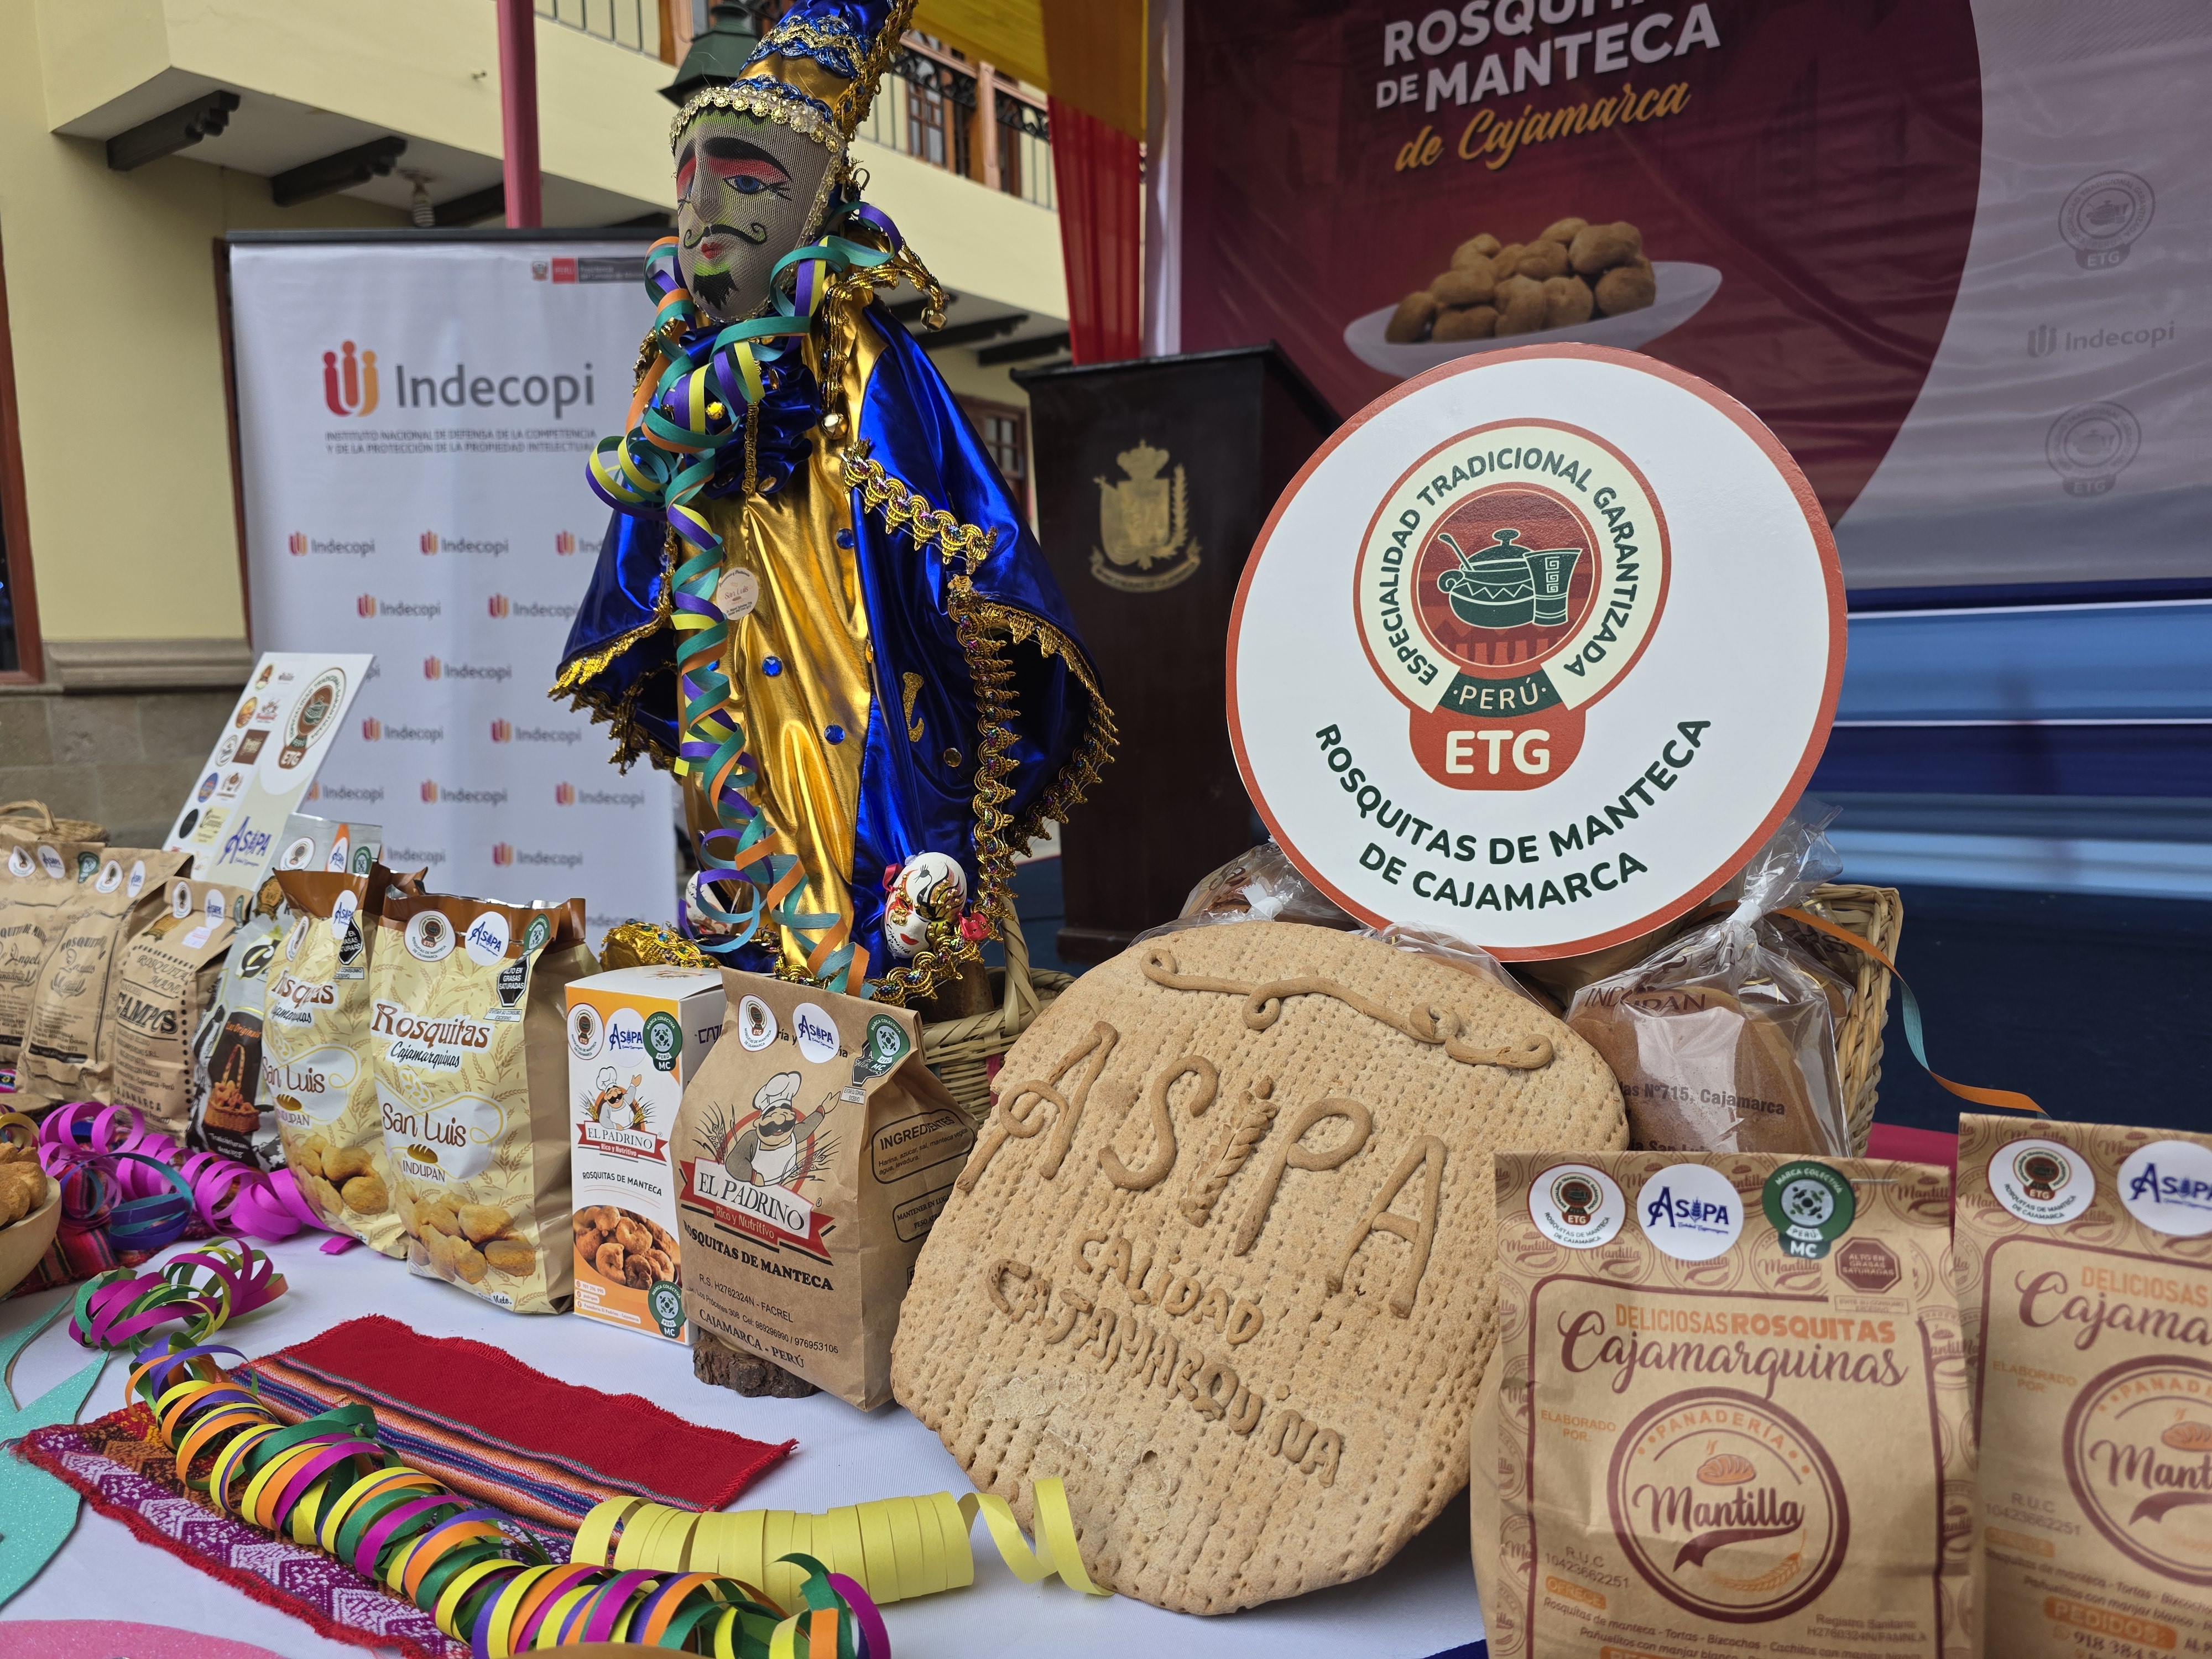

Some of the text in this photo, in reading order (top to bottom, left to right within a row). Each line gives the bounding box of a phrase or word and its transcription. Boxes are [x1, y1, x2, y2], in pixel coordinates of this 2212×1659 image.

[1377, 3, 1720, 112] DE MANTECA
[1395, 82, 1689, 171] de Cajamarca
[2087, 251, 2119, 267] ETG
[2065, 321, 2176, 353] Indecopi
[395, 361, 595, 420] Indecopi
[381, 428, 597, 441] NACIONAL DEFENSA COMPETENCIA
[465, 442, 525, 453] PROPIEDAD
[1416, 447, 1593, 507] TRADICIONAL
[2073, 479, 2106, 494] ETG
[311, 538, 375, 556] Indecopi
[442, 539, 509, 556] Indecopi
[1563, 487, 1640, 677] GARANTIZADA
[1379, 508, 1439, 686] ESPECIALIDAD
[380, 601, 441, 619] Indecopi
[444, 664, 512, 681] Indecopi
[384, 726, 444, 743] Indecopi
[515, 726, 582, 744] Indecopi
[1445, 729, 1550, 775] ETG
[323, 786, 384, 804] Indecopi
[441, 787, 508, 805] Indecopi
[578, 790, 645, 806] Indecopi
[1316, 720, 1711, 865] ROSQUITAS DE MANTECA
[388, 847, 446, 865] Indecopi
[517, 849, 583, 868] Indecopi
[1359, 842, 1648, 911] DE CAJAMARCA
[468, 921, 502, 952] ASIPA
[372, 1004, 491, 1049] Rosquitas
[646, 1016, 676, 1030] MARCA COLECTIVA
[798, 1014, 834, 1045] ASIPA
[870, 1018, 901, 1034] MARCA COLECTIVA
[609, 1023, 643, 1051] ASIPA
[390, 1041, 460, 1069] Cajamarquinas
[262, 1056, 325, 1093] San Luis
[1700, 1088, 1785, 1115] Cajamarca
[383, 1102, 467, 1147] San Luis
[880, 1116, 955, 1150] INGREDIENTES
[588, 1128, 653, 1150] EL PADRINO
[615, 1146, 637, 1157] Nutritivo
[879, 1156, 899, 1167] Harina,
[900, 1148, 919, 1159] azucar,
[930, 1135, 953, 1147] manteca
[954, 1127, 968, 1138] vegetal
[403, 1160, 446, 1183] INDUPAN
[879, 1155, 920, 1175] agua, levadura.
[583, 1171, 662, 1196] ROSQUITAS DE MANTECA
[1775, 1167, 1844, 1195] MARCA COLECTIVA
[698, 1172, 805, 1231] EL PADRINO
[2030, 1190, 2050, 1199] ETG
[2047, 1194, 2077, 1212] MANTECA
[897, 1203, 928, 1221] MANTENER
[928, 1199, 935, 1208] EN
[1568, 1215, 1586, 1224] ETG
[1647, 1186, 1729, 1229] ASIPA
[2022, 1209, 2065, 1220] CAJAMARCA
[716, 1206, 775, 1239] Rico y Nutritivo
[914, 1218, 928, 1229] PESO
[1545, 1212, 1611, 1237] ROSQUITAS MANTECA
[1501, 1238, 1557, 1254] Mantilla
[1563, 1236, 1601, 1244] CAJAMARCA
[1790, 1240, 1818, 1258] MC
[683, 1219, 834, 1291] ROSQUITAS DE MANTECA
[1757, 1259, 1822, 1274] Mantilla
[1843, 1267, 1895, 1276] SATURADAS
[651, 1285, 663, 1296] MARCA
[662, 1284, 681, 1299] COLECTIVA
[700, 1274, 794, 1323] R.S. H2762324N FACREL
[2081, 1265, 2209, 1309] DELICIOSAS
[493, 1296, 512, 1305] Neto.
[664, 1327, 675, 1337] MC
[706, 1295, 839, 1354] Próceres 308 Cel: 989296990 976953105
[1616, 1303, 1896, 1344] DELICIOSAS ROSQUITAS
[700, 1308, 805, 1369] CAJAMARCA PERÚ
[1557, 1310, 1909, 1400] Cajamarquinas
[1993, 1360, 2078, 1386] ELABORADO
[1541, 1409, 1617, 1432] ELABORADO
[1656, 1409, 1785, 1449] PANADERÍA
[1632, 1483, 1805, 1534] Mantilla
[1544, 1597, 1817, 1656] Rosquitas de manteca Tortas Bizcochos Cachitos
[1816, 1614, 1865, 1629] Registro
[1580, 1626, 1635, 1648] Pañuelitos
[1636, 1641, 1656, 1651] con
[1659, 1644, 1698, 1658] manjar
